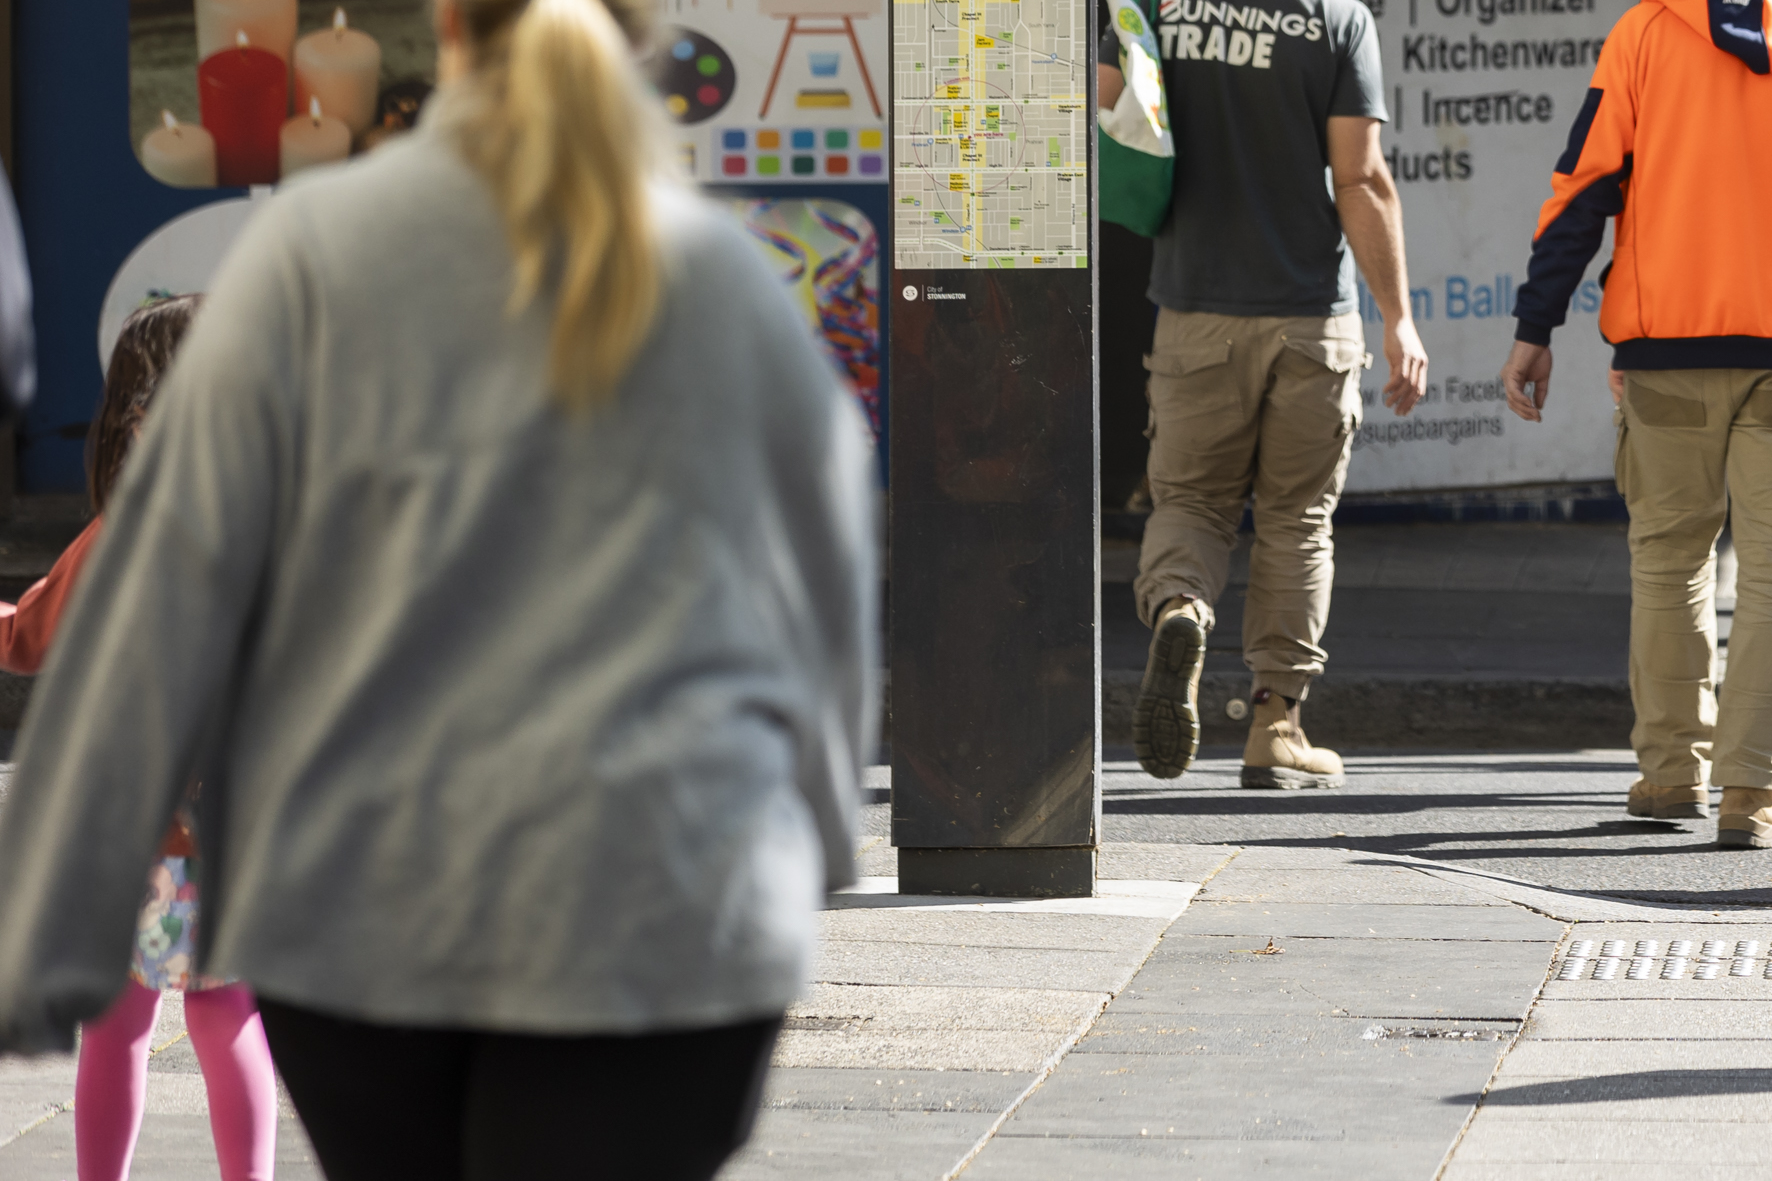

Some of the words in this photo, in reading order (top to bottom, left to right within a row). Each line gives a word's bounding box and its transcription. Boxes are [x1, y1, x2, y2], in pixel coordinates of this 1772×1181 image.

[1158, 23, 1277, 69] TRADE
[1422, 89, 1555, 127] Incence
[1384, 144, 1475, 182] ducts
[927, 286, 938, 294] City
